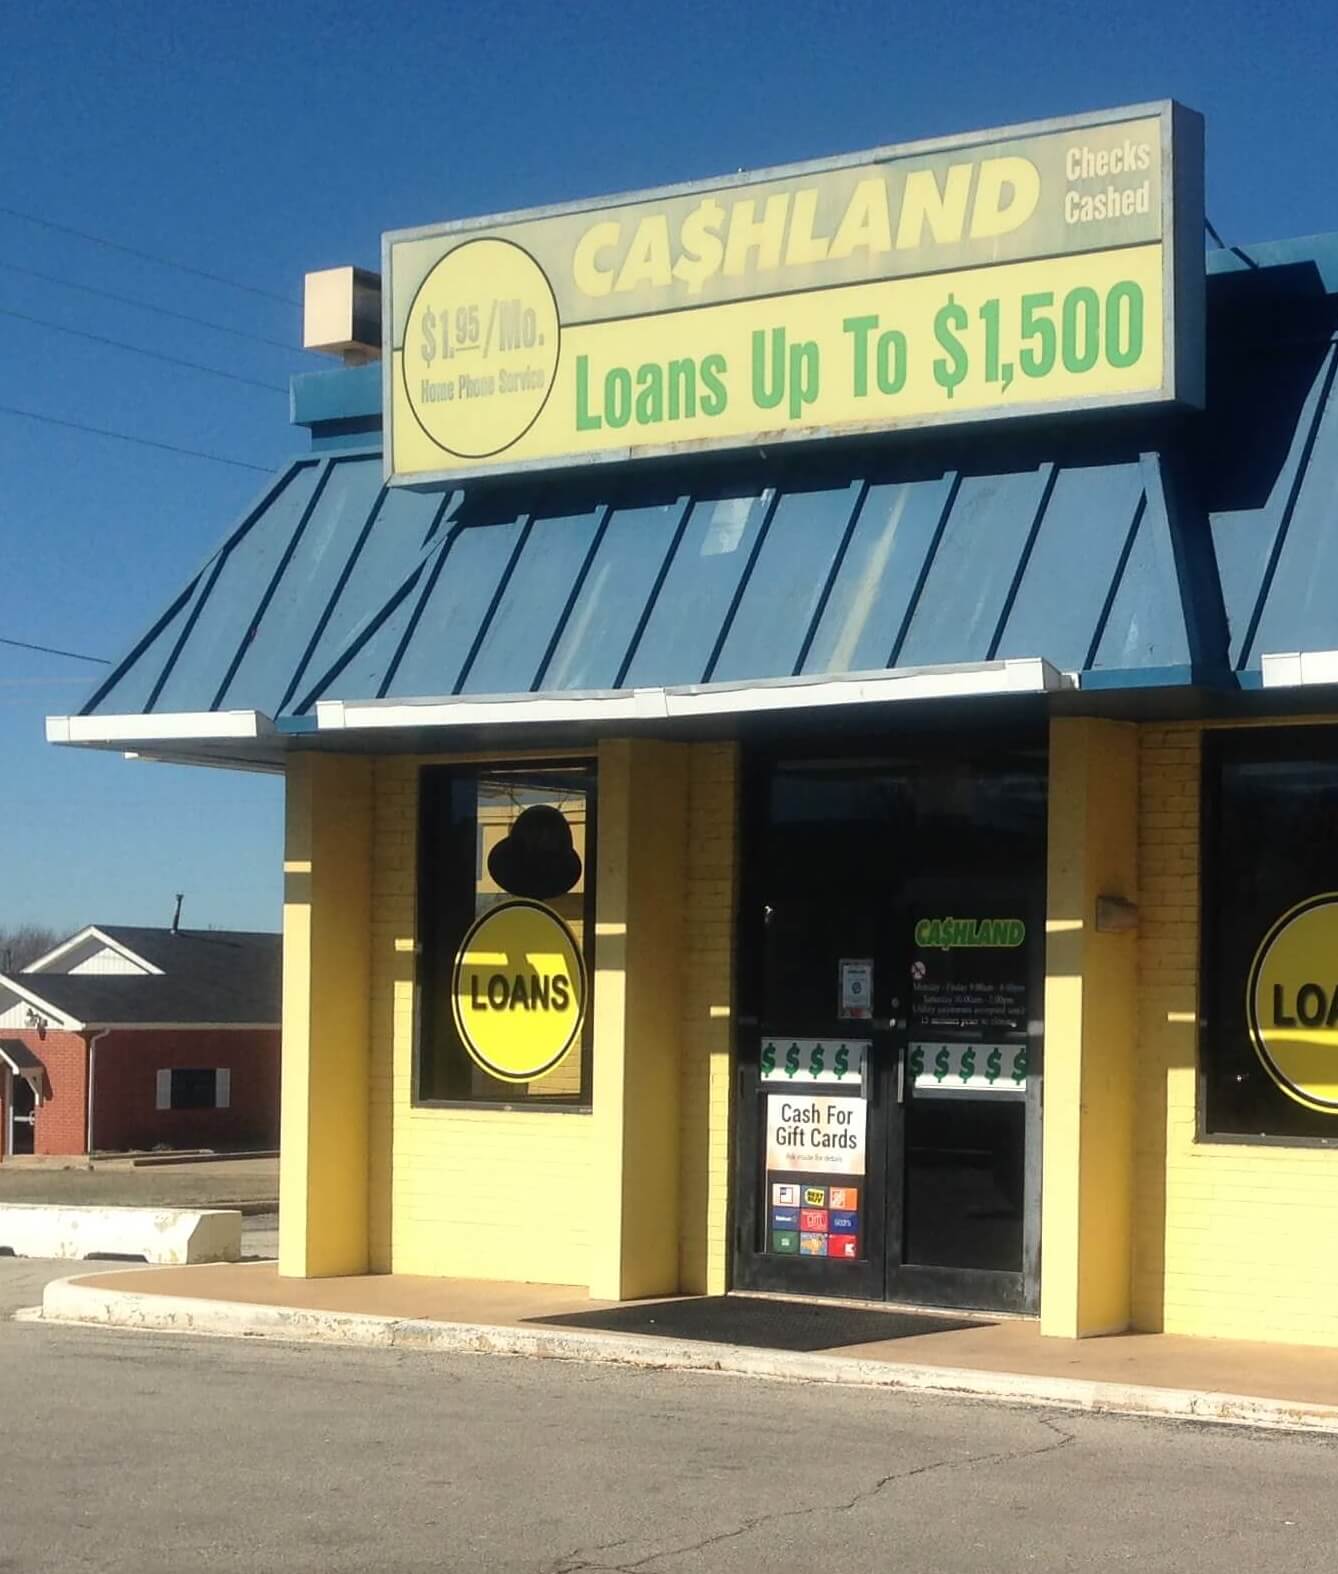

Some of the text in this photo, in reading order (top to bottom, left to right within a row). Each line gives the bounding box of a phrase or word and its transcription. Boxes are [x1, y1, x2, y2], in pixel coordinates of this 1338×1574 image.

[1066, 139, 1151, 181] Checks
[1065, 181, 1149, 224] Cashed
[573, 157, 1041, 297] CA$HLAND
[575, 280, 1144, 432] Loans Up To $1,500
[421, 365, 545, 403] Home Phone Service
[471, 974, 569, 1011] LOANS
[781, 1103, 853, 1125] Cash For
[776, 1126, 857, 1149] Gift Cards
